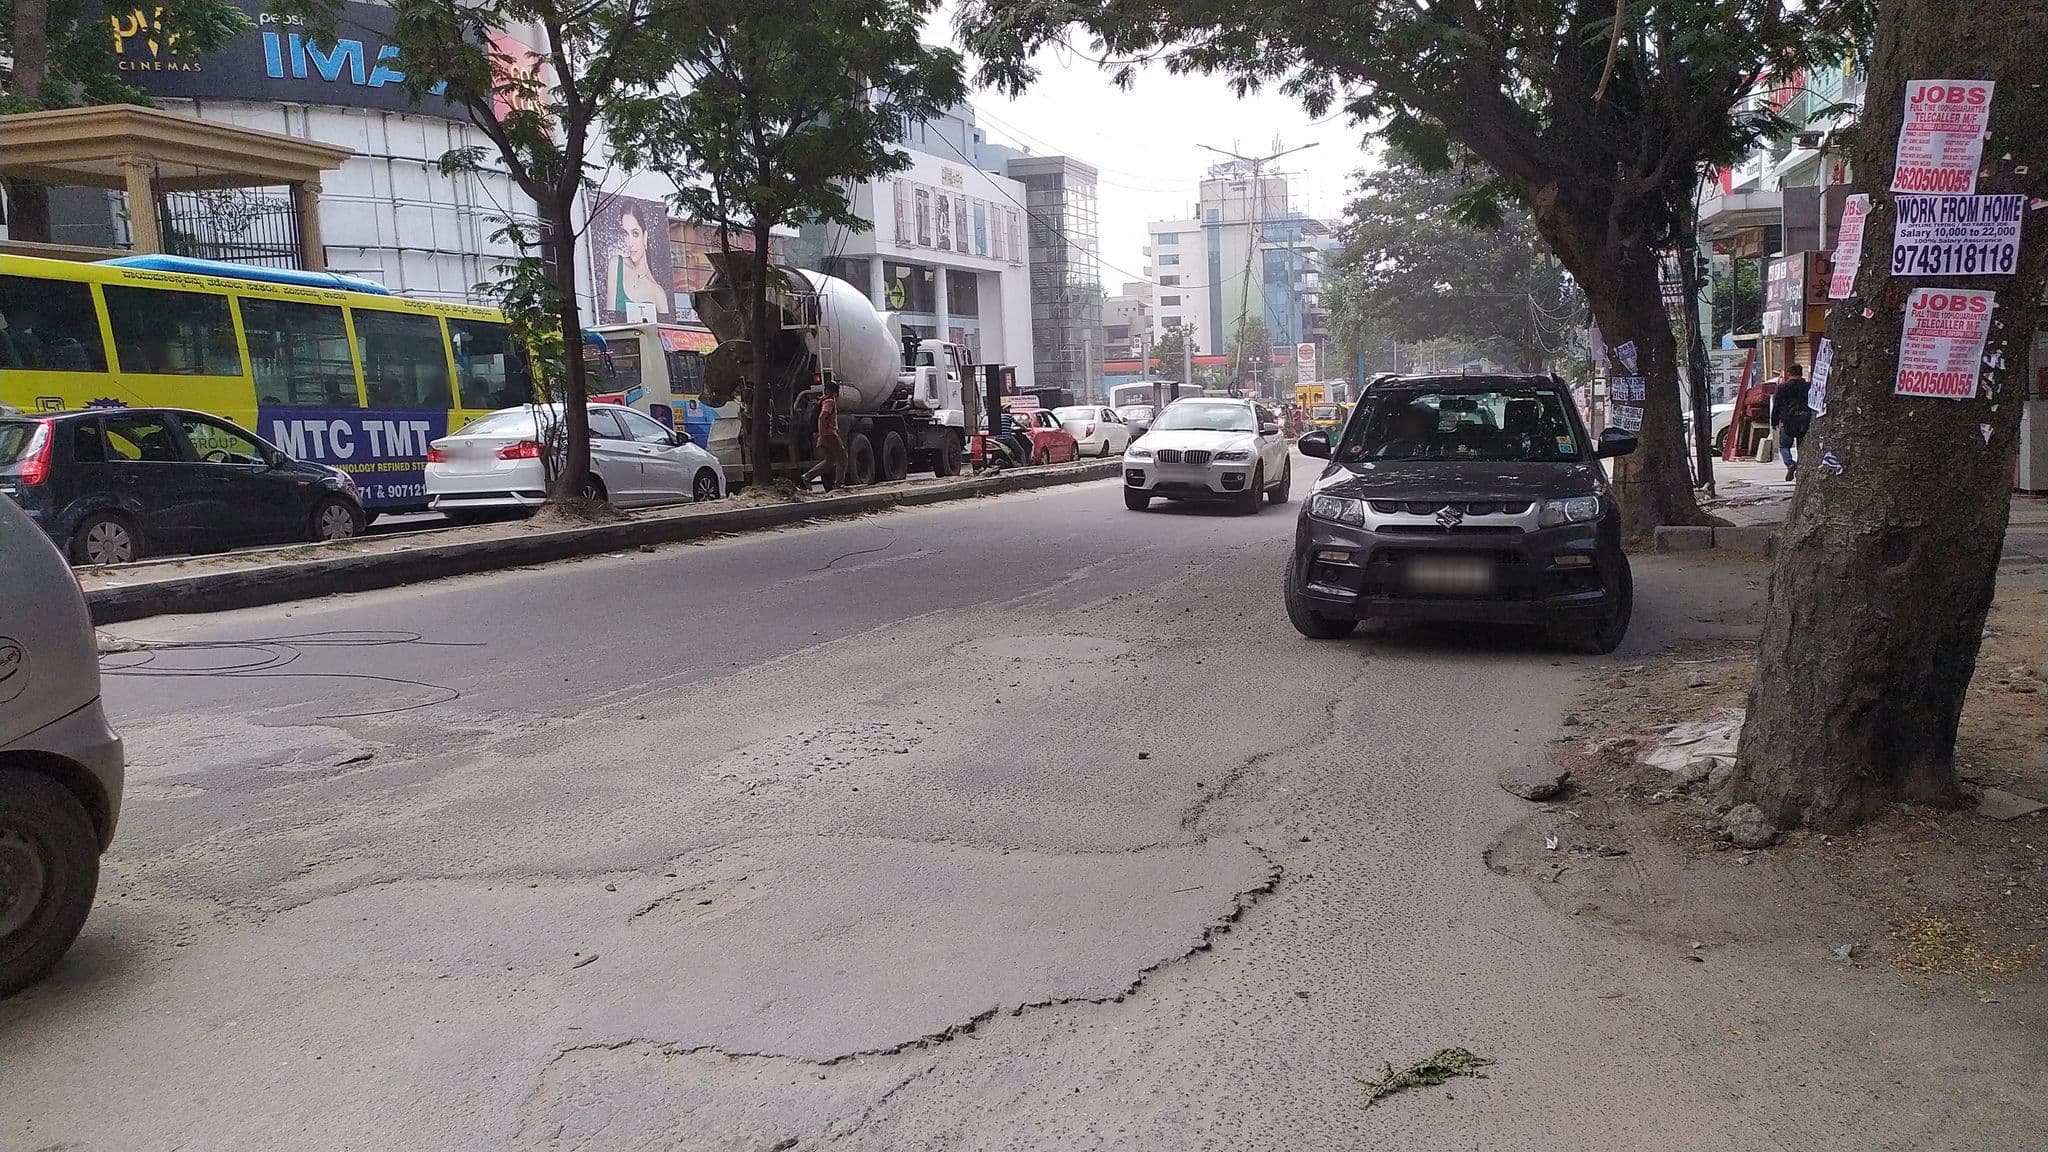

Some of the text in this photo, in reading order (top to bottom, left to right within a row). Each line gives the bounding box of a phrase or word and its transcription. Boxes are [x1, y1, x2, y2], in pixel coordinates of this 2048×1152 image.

[118, 61, 201, 72] CINEMAS
[262, 31, 448, 96] IMA
[1910, 86, 1986, 105] JOBS
[1915, 112, 1978, 124] TELECALLER M/F
[1894, 166, 1973, 192] 9620500055
[1900, 195, 2022, 224] WORK FROM HOME
[1900, 226, 2016, 238] Salary 10,000 to 22,000
[1894, 244, 2015, 273] 9743118118
[1912, 293, 1987, 313] JOBS
[1911, 309, 1925, 318] FULL
[1926, 310, 1940, 319] TIME
[1916, 318, 1981, 331] TELECALLER M/F
[1897, 369, 1974, 395] 9620500055
[272, 419, 430, 459] MTC TMT
[377, 462, 410, 472] REFINED
[412, 462, 425, 471] STE
[376, 485, 385, 499] &
[388, 483, 427, 498] 907121
